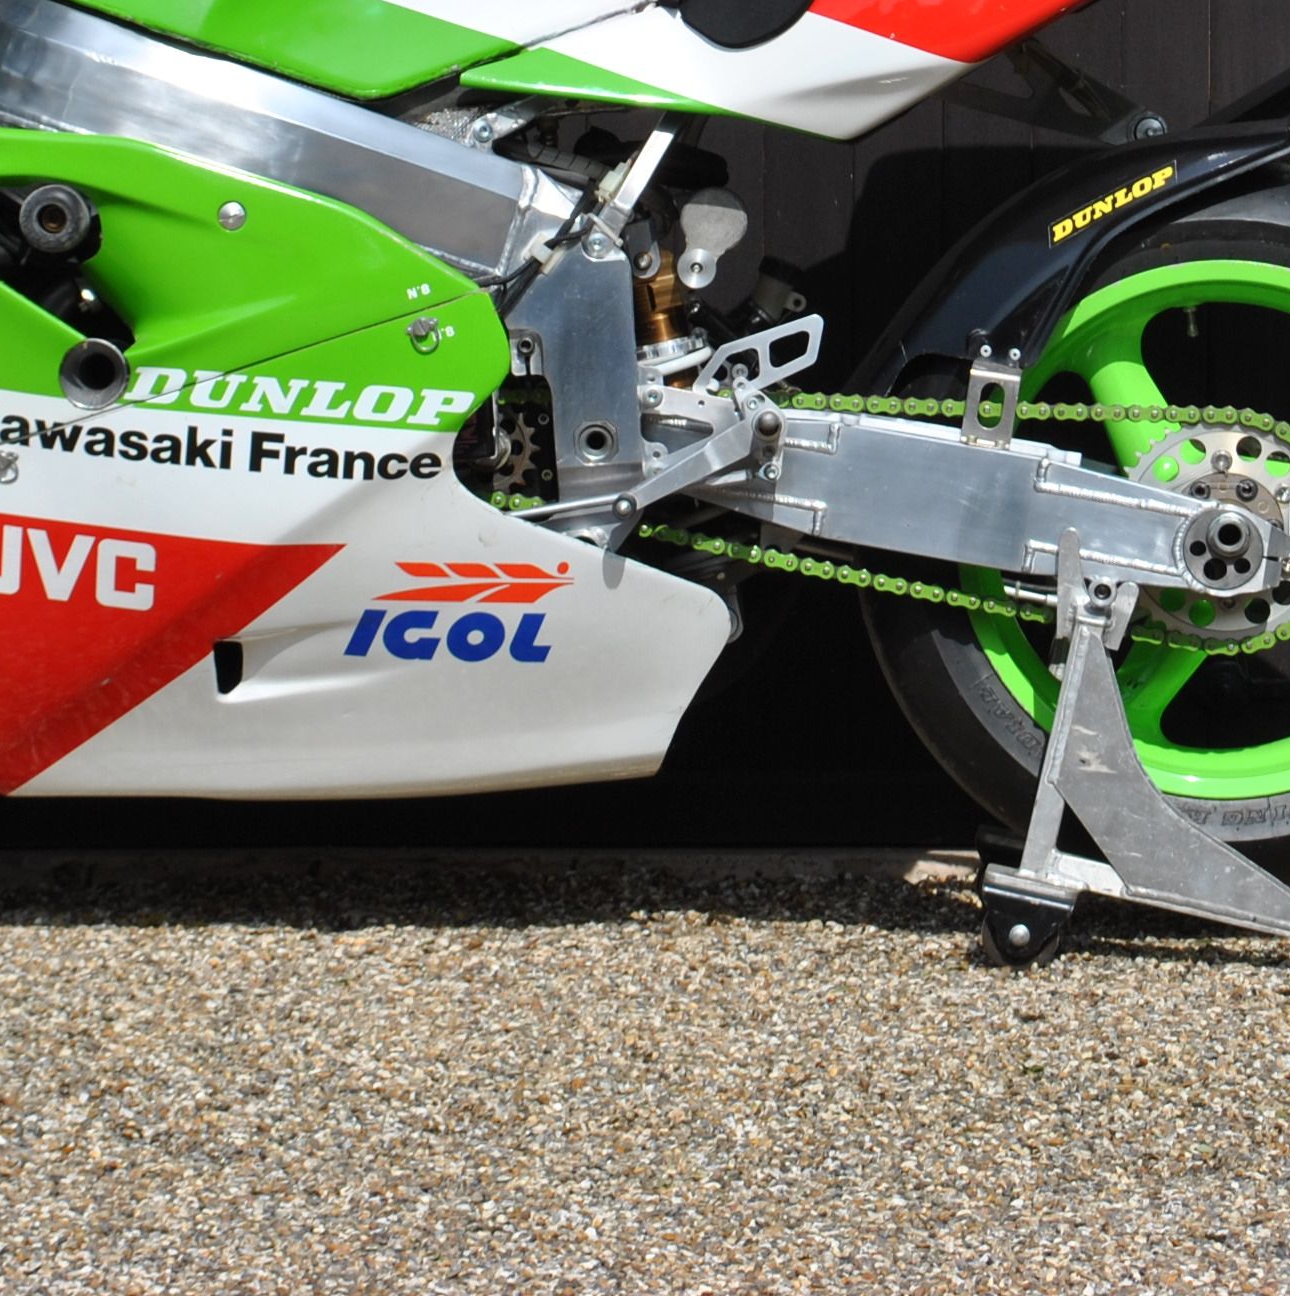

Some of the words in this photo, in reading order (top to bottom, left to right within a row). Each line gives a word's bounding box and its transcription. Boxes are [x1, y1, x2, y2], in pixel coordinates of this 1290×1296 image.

[1052, 165, 1174, 242] DUNLOP
[124, 366, 475, 425] DUNLOP
[248, 431, 442, 480] France
[343, 608, 552, 663] IGOL
